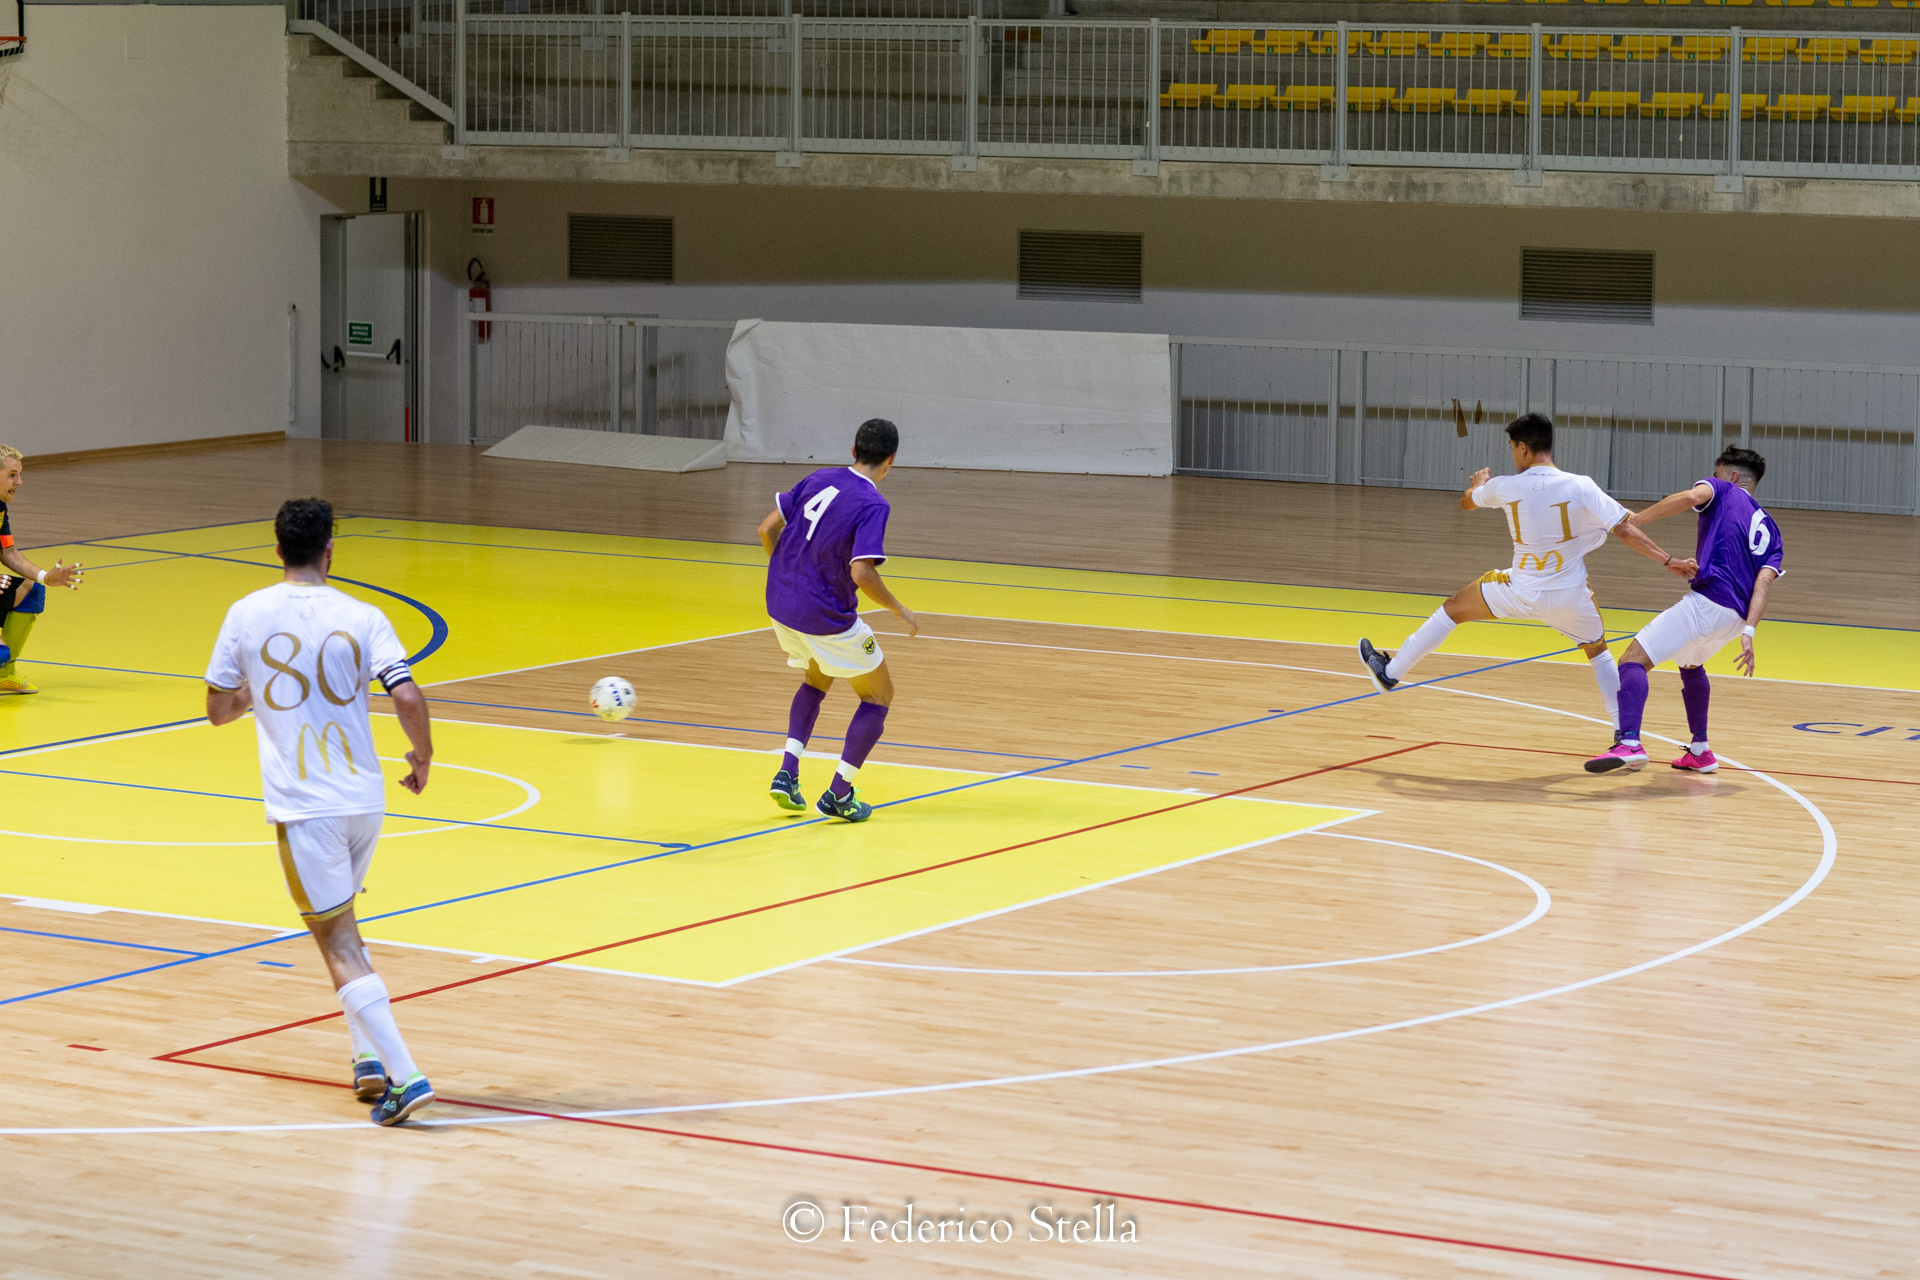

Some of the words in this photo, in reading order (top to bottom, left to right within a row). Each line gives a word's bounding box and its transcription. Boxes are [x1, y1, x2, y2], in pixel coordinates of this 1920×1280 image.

[804, 485, 840, 541] 4
[1505, 499, 1578, 546] 11
[1749, 508, 1770, 556] 6
[260, 630, 361, 711] 80
